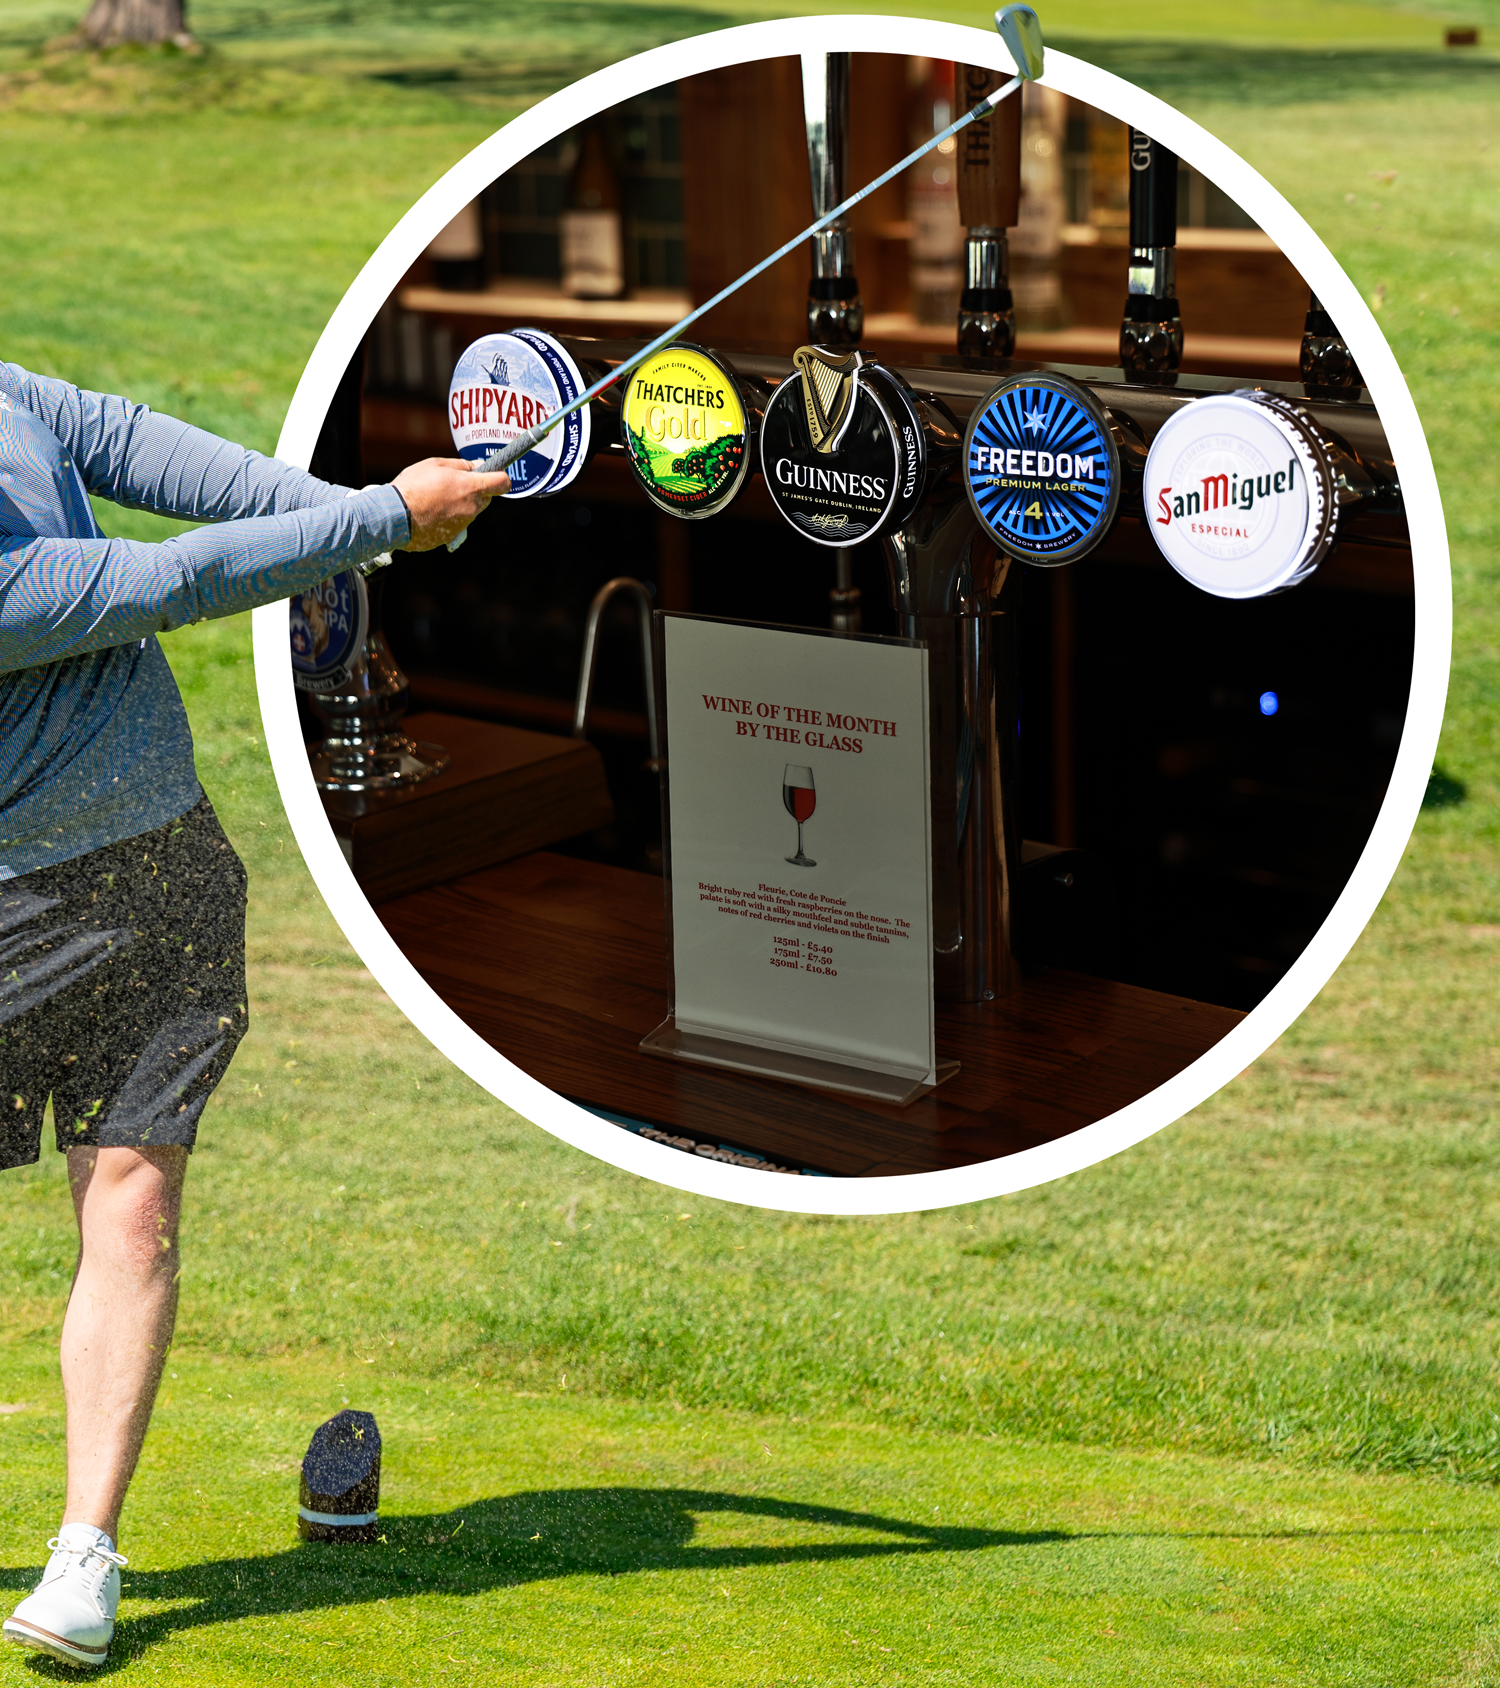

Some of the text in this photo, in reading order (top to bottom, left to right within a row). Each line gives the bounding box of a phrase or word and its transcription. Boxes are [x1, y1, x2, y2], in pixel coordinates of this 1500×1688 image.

[1131, 128, 1151, 171] GU
[636, 379, 724, 409] THATCHERS
[451, 388, 549, 438] SHIPYARD
[645, 404, 708, 442] Gold
[471, 428, 500, 440] PORTLAND
[810, 417, 819, 438] 1759
[562, 424, 579, 467] SHIPYARD
[902, 425, 917, 499] GUINNESS
[977, 446, 1095, 480] FREEDOM
[1174, 438, 1266, 483] EXPLORING THE WORLD
[775, 458, 886, 500] GUINNESS
[985, 477, 1086, 492] PREMIUM LAGER
[657, 487, 689, 502] SOMERSET
[689, 491, 708, 502] CIDER
[814, 497, 829, 505] GATE
[855, 505, 882, 513] IRELAND
[1024, 501, 1043, 520] 4
[999, 527, 1076, 549] FREEDOM BREWERY
[1191, 523, 1250, 539] ESPECIAL
[1196, 537, 1223, 556] SINCE
[323, 607, 349, 634] IPA
[702, 694, 898, 738] WINE OF THE MONTH
[735, 720, 863, 754] BY THE GLASS
[698, 882, 911, 928] Bright ruby red with fresh raspberries on the nose. The
[758, 883, 847, 906] Fleurie, Cote de Poncie
[699, 892, 723, 903] palate
[724, 896, 732, 904] is
[732, 899, 747, 907] soft
[748, 901, 765, 911] with
[772, 906, 792, 917] silky
[792, 910, 832, 923] mouthfeel
[833, 917, 849, 926] and
[850, 920, 875, 931] subtle
[875, 925, 910, 939] tannins,
[718, 906, 739, 915] notes
[763, 913, 796, 926] cherries
[796, 921, 812, 929] and
[813, 923, 839, 934] violets
[840, 929, 851, 937] on
[852, 930, 865, 939] the
[866, 932, 890, 944] finish
[773, 936, 800, 947] 125ml
[807, 941, 833, 954] £5.40
[774, 947, 800, 958] 175ml
[807, 952, 833, 965] £7.50
[769, 957, 799, 969] 250ml
[806, 963, 837, 977] £10.80
